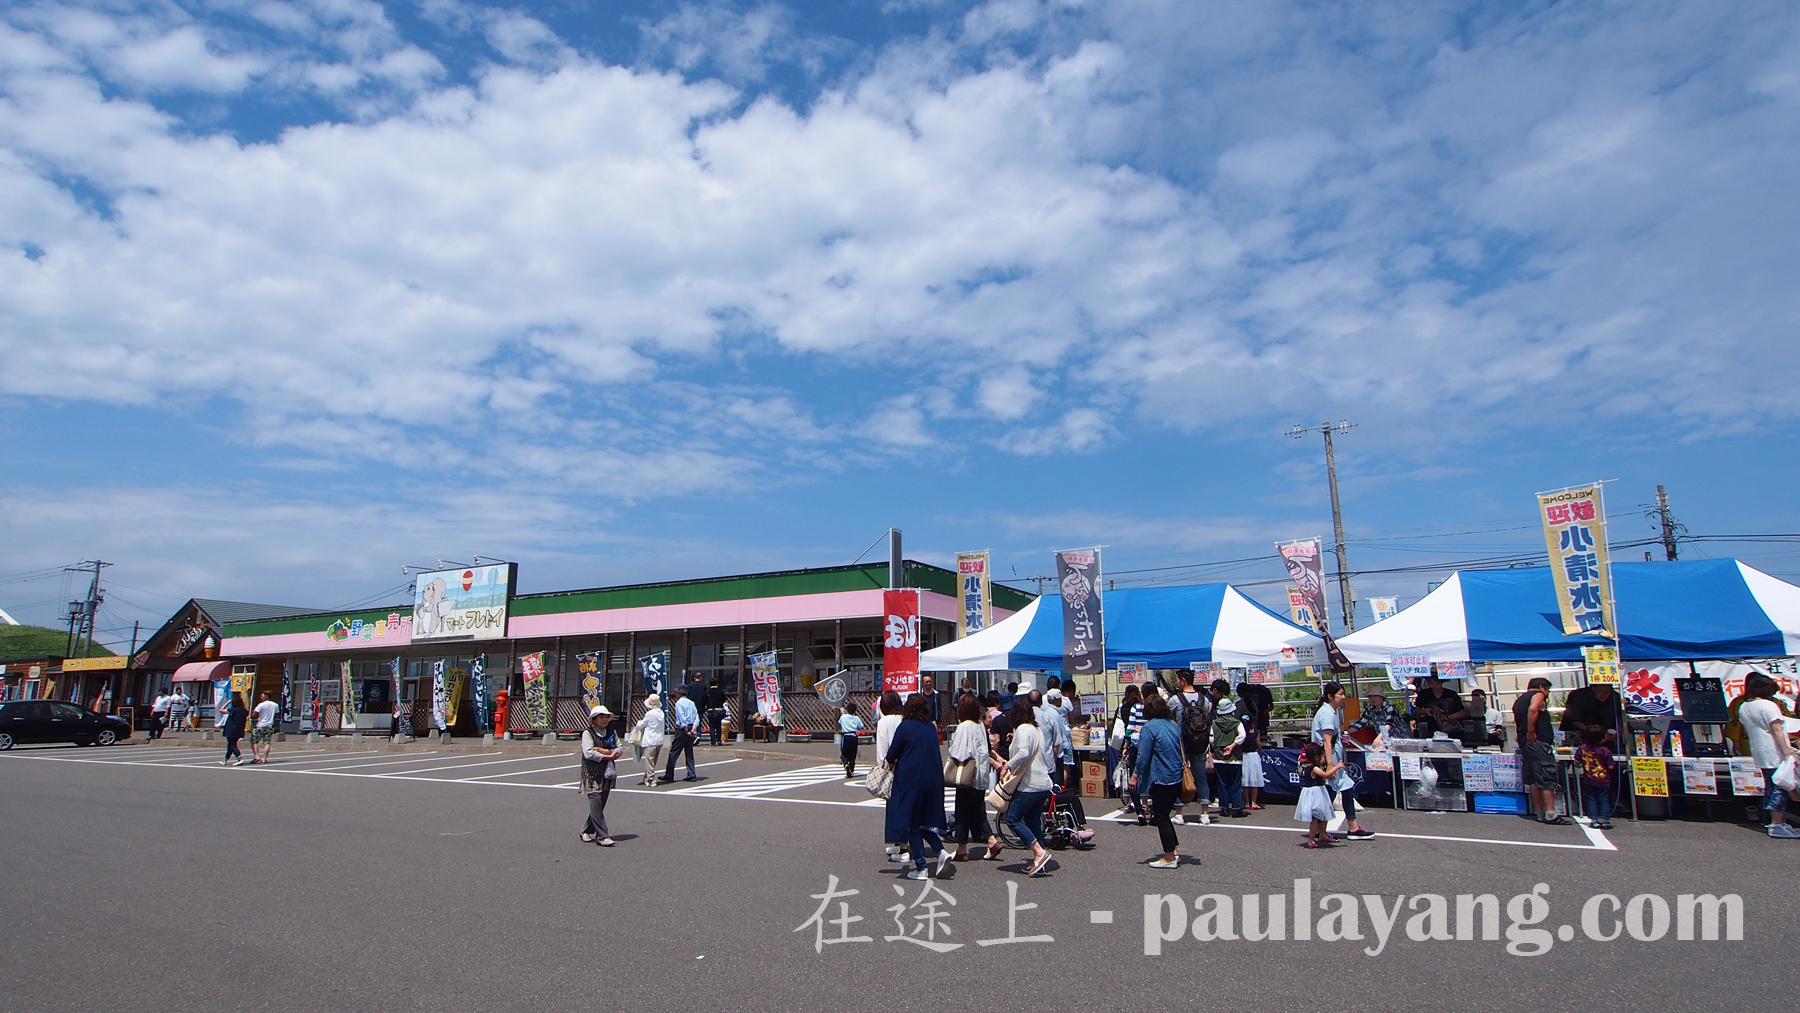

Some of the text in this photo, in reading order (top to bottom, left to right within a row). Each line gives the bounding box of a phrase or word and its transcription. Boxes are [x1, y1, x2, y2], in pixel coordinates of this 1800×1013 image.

[351, 613, 412, 641] 野菜直売所
[446, 608, 503, 631] マート フレトイ
[1627, 669, 1664, 698] 氷
[1682, 681, 1718, 691] かき氷
